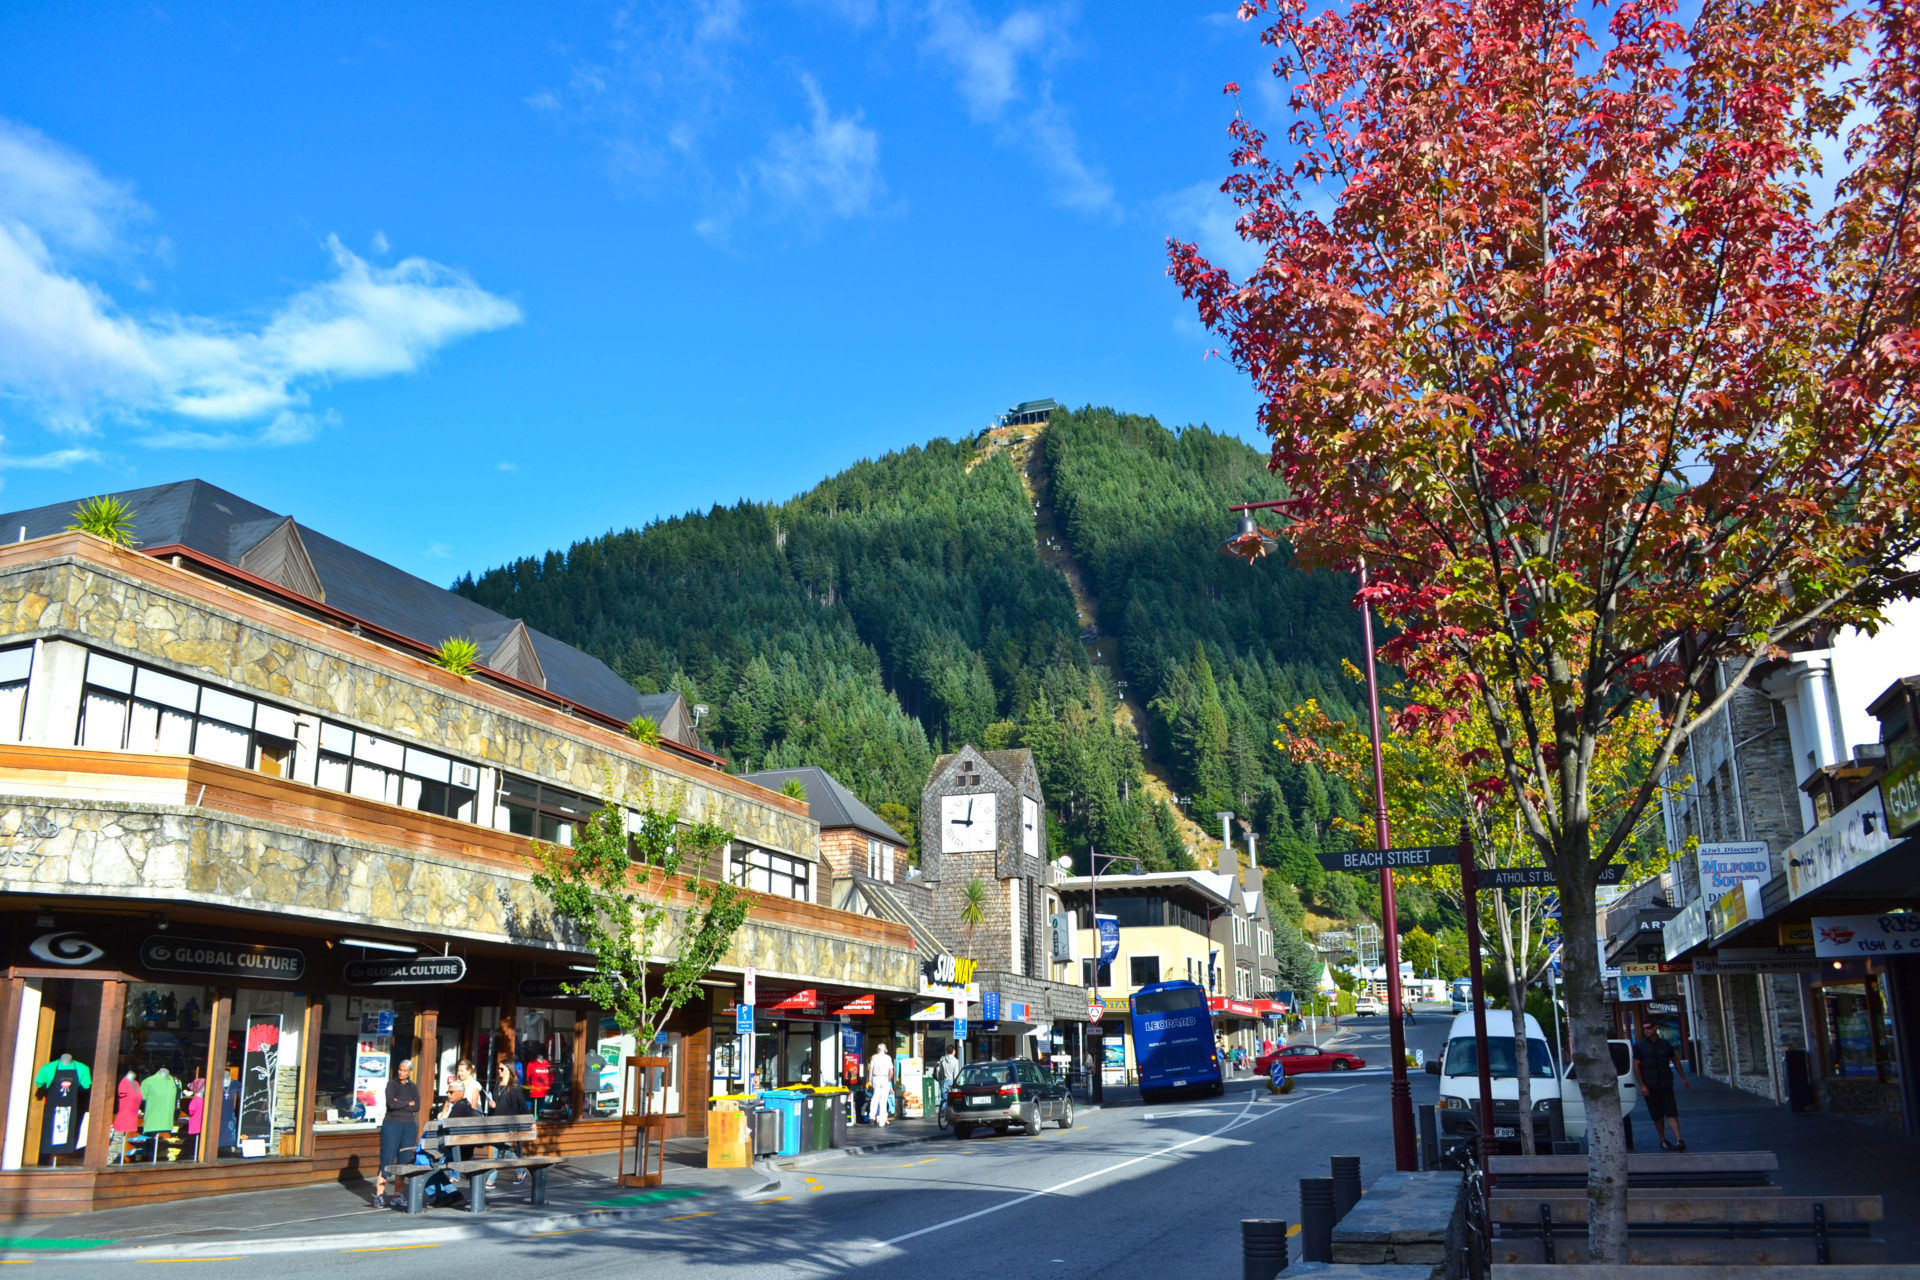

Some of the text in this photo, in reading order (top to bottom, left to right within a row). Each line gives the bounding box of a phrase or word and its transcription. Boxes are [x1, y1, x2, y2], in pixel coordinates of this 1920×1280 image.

[1889, 773, 1918, 818] GOLF
[1343, 849, 1431, 867] BEACH STREET
[1703, 860, 1767, 874] MILFORD
[1495, 871, 1527, 884] ATHOL
[1529, 871, 1541, 883] ST
[1857, 939, 1887, 951] FISH
[1892, 940, 1903, 950] &
[175, 948, 298, 971] GLOBAL CULTURE
[367, 964, 458, 977] GLOBAL CULTURE
[933, 954, 978, 985] SUBWAY
[1144, 1016, 1197, 1032] LEOPARD
